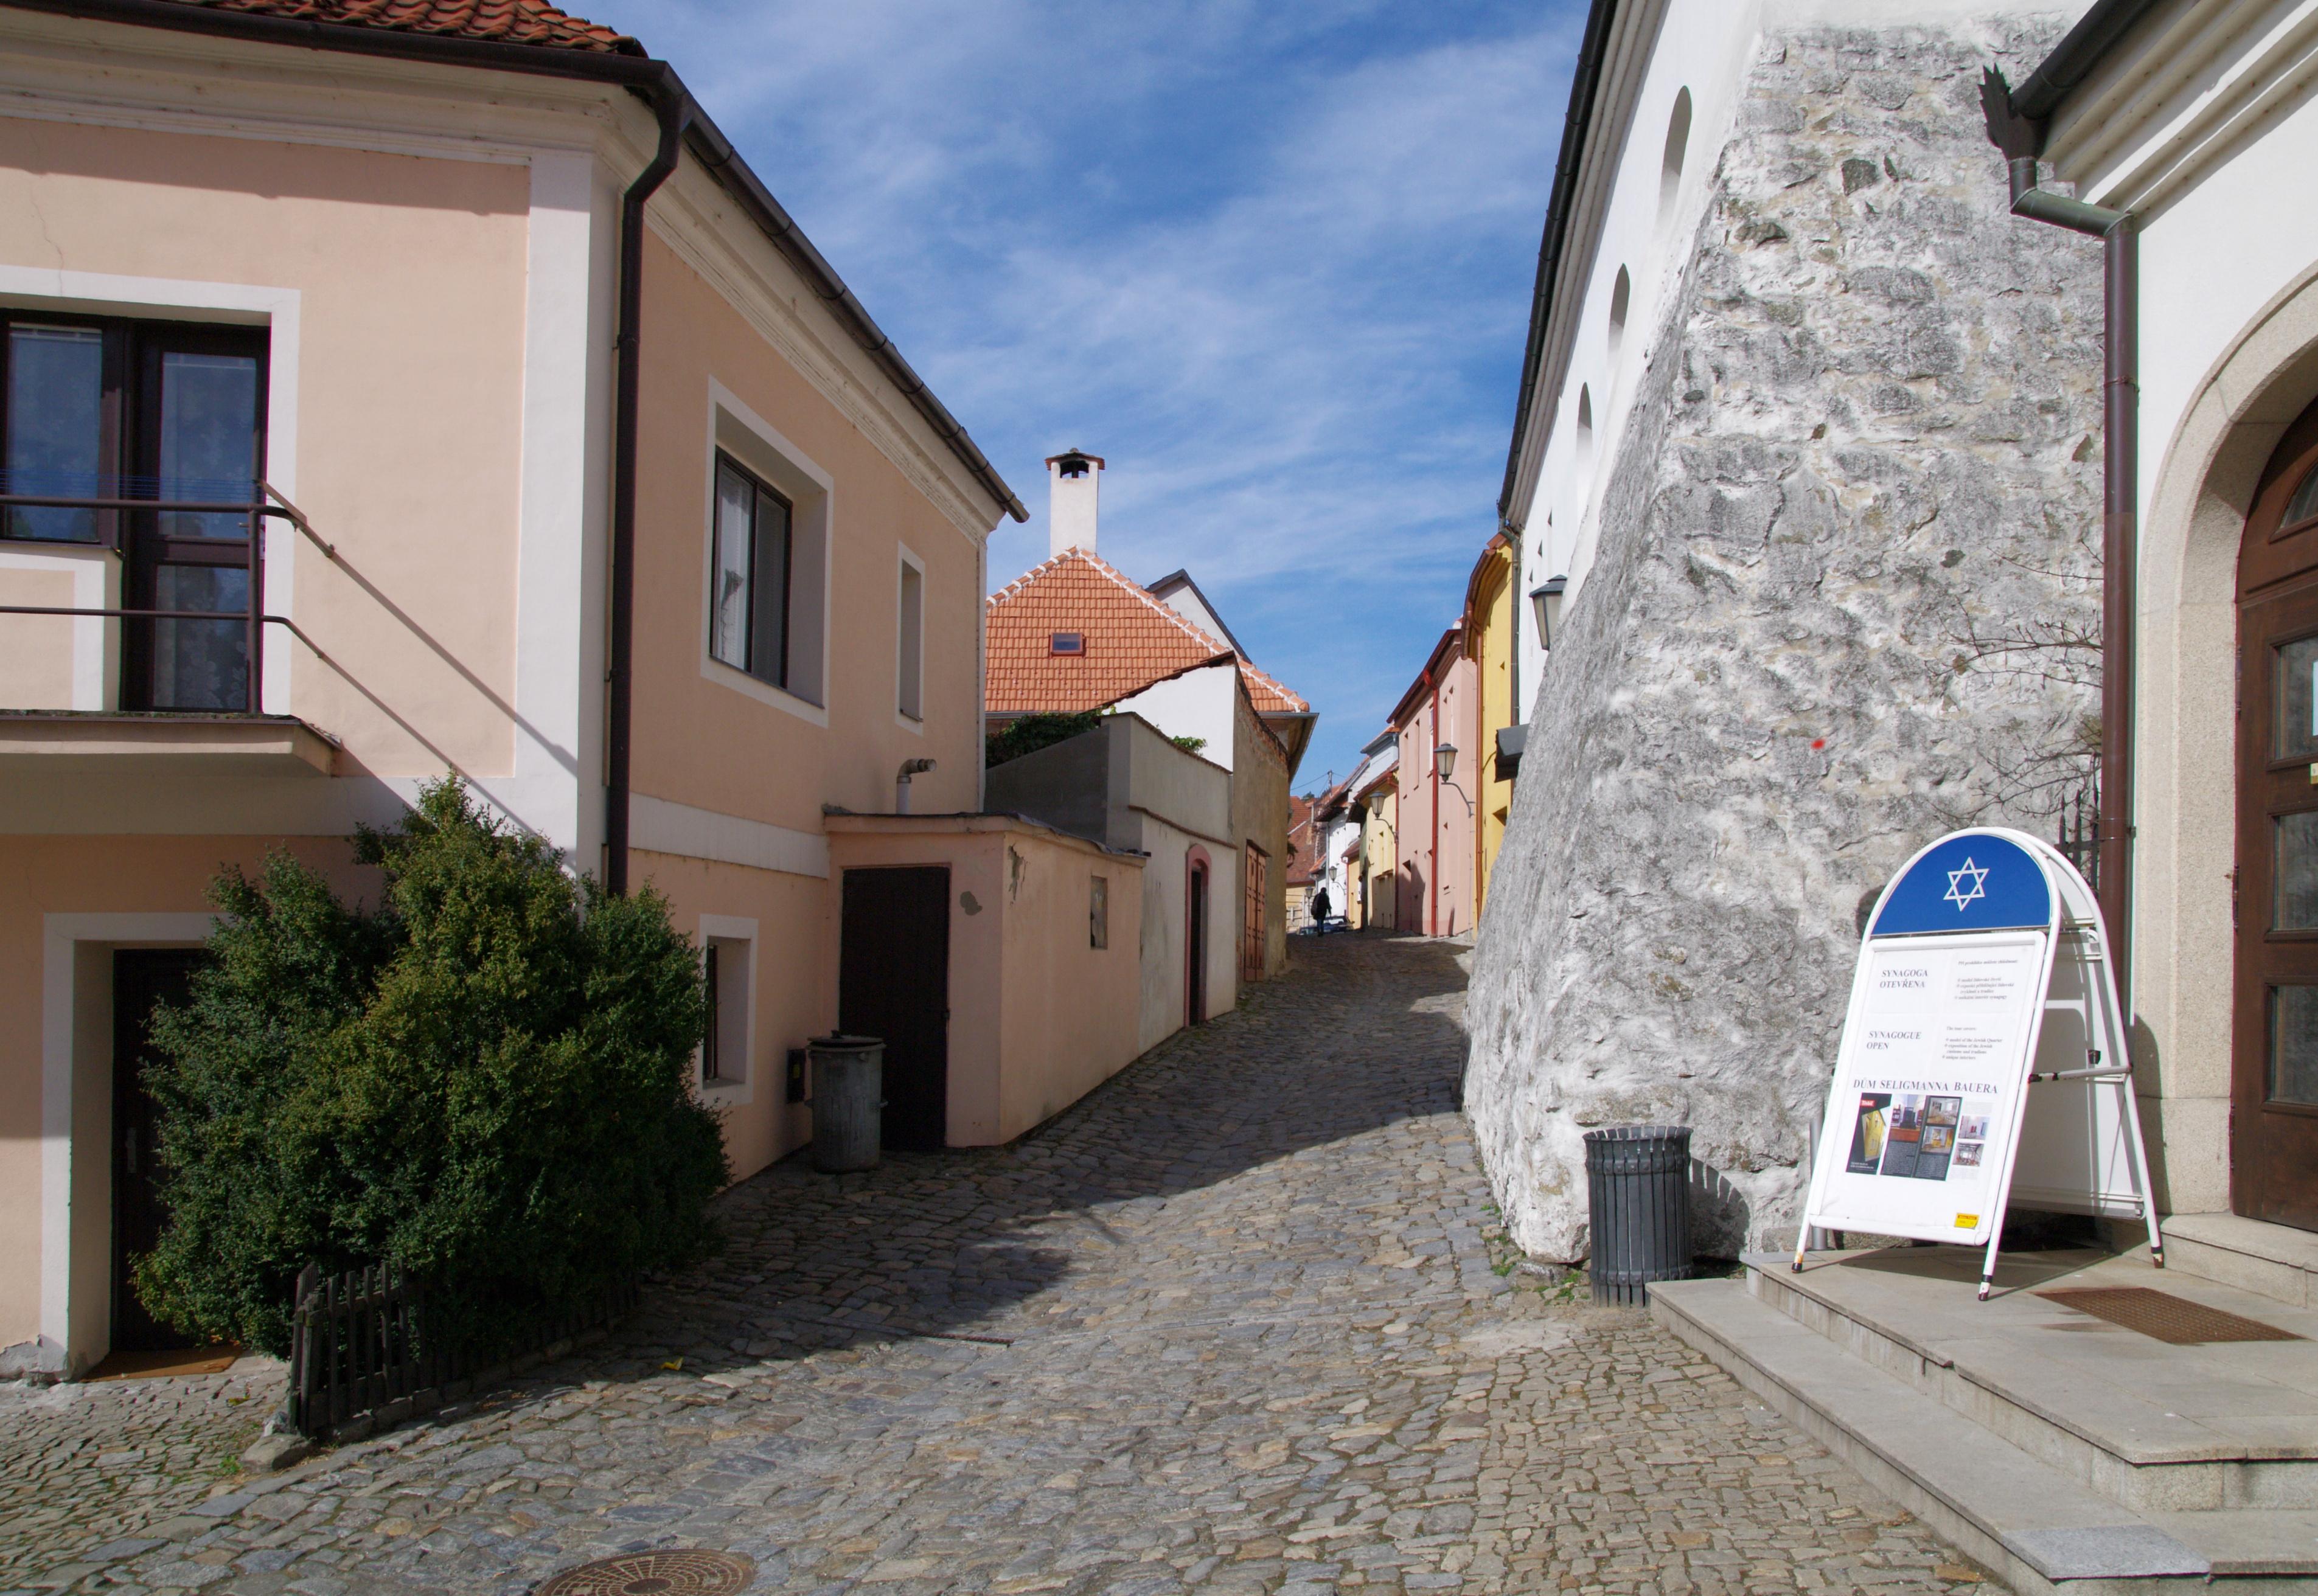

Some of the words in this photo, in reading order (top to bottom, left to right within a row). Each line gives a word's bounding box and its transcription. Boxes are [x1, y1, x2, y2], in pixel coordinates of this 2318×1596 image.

[1881, 969, 1928, 977] SYNAGOGA
[1879, 979, 1925, 988] OTEVŘENA
[1868, 1030, 1922, 1039] SYNAGOGUE
[1866, 1041, 1889, 1050] OPEN
[1853, 1077, 1877, 1089] DŮM
[1879, 1079, 1949, 1092] SELIGMANNA
[1954, 1081, 1998, 1094] BAUERA
